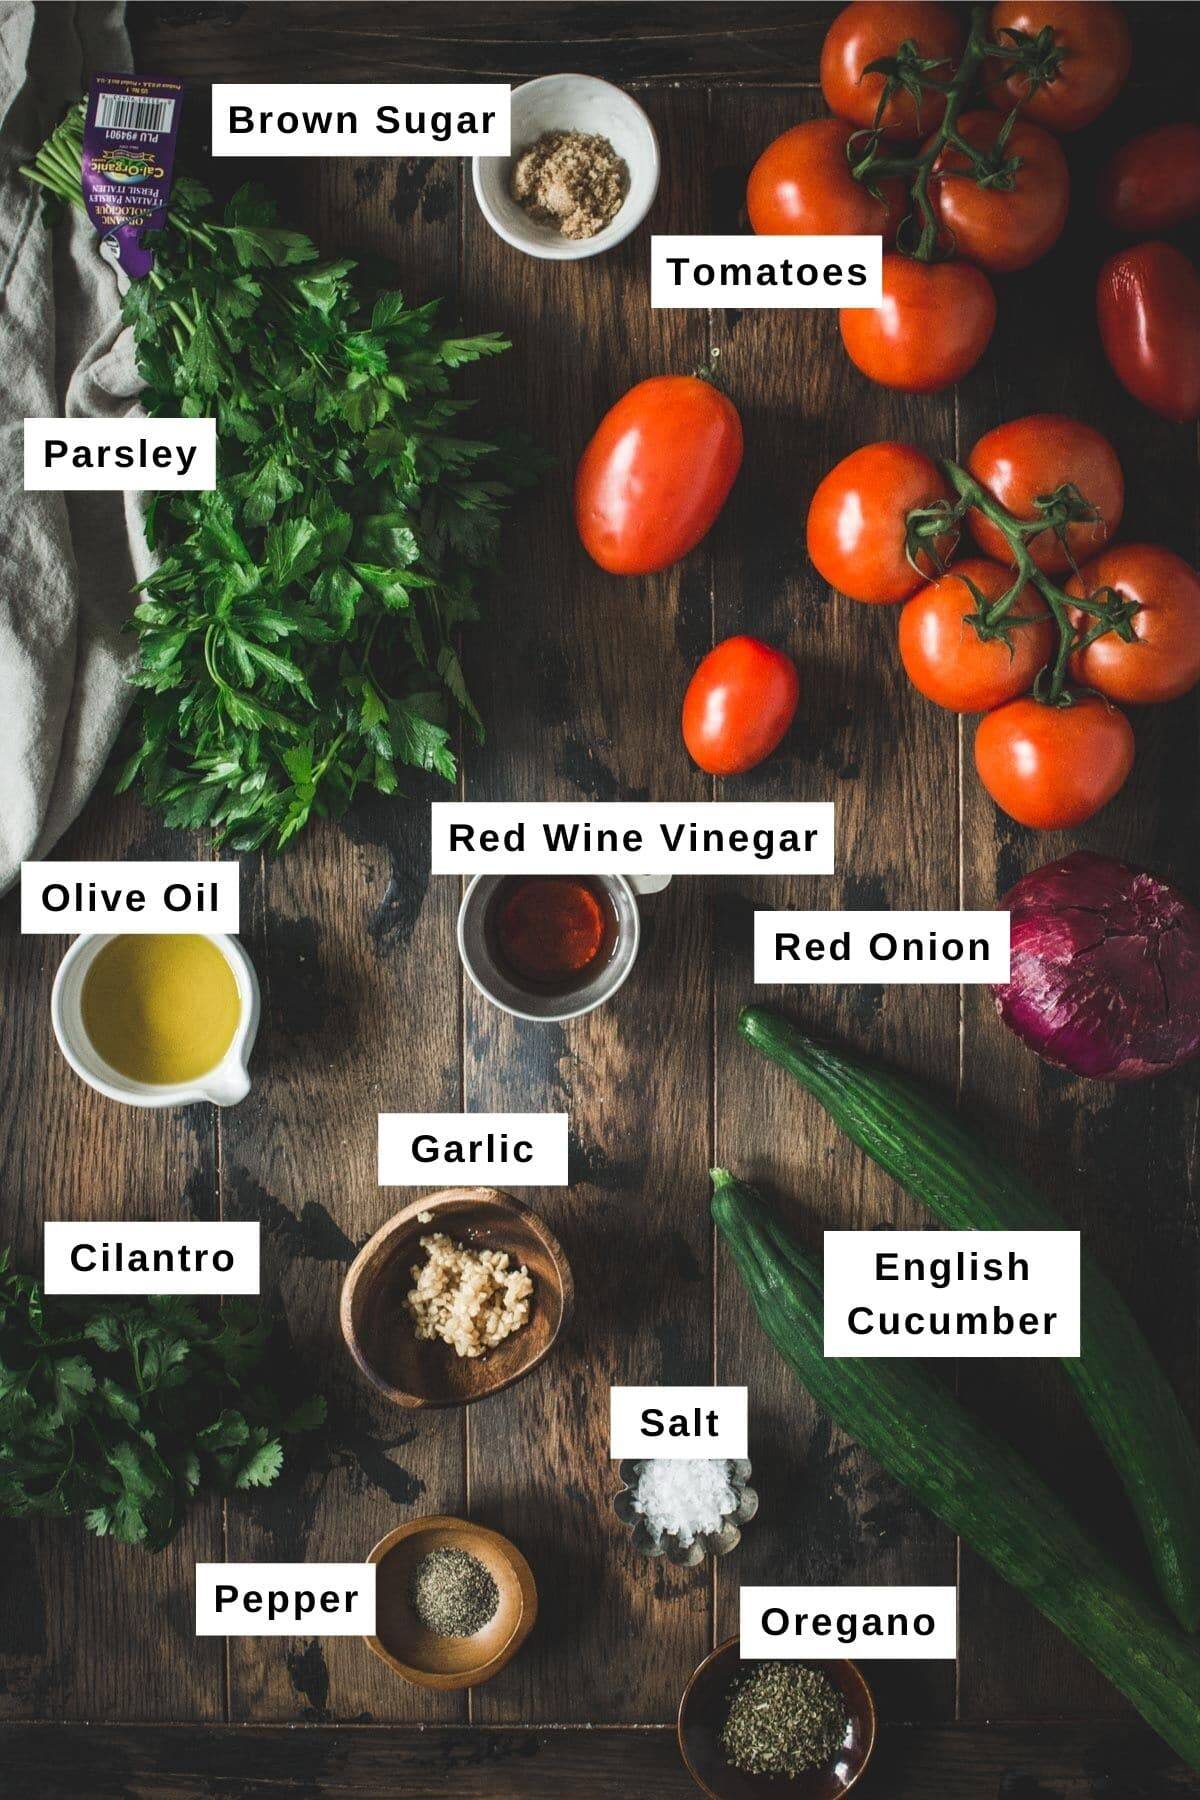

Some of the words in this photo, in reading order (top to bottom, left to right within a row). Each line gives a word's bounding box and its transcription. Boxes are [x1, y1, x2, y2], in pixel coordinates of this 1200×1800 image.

[105, 129, 138, 141] #94901
[140, 132, 159, 143] PLU
[92, 184, 126, 193] ITALIEN
[128, 187, 159, 198] PERSIL
[89, 194, 122, 203] PARSLEY
[125, 196, 163, 206] ITALIAN
